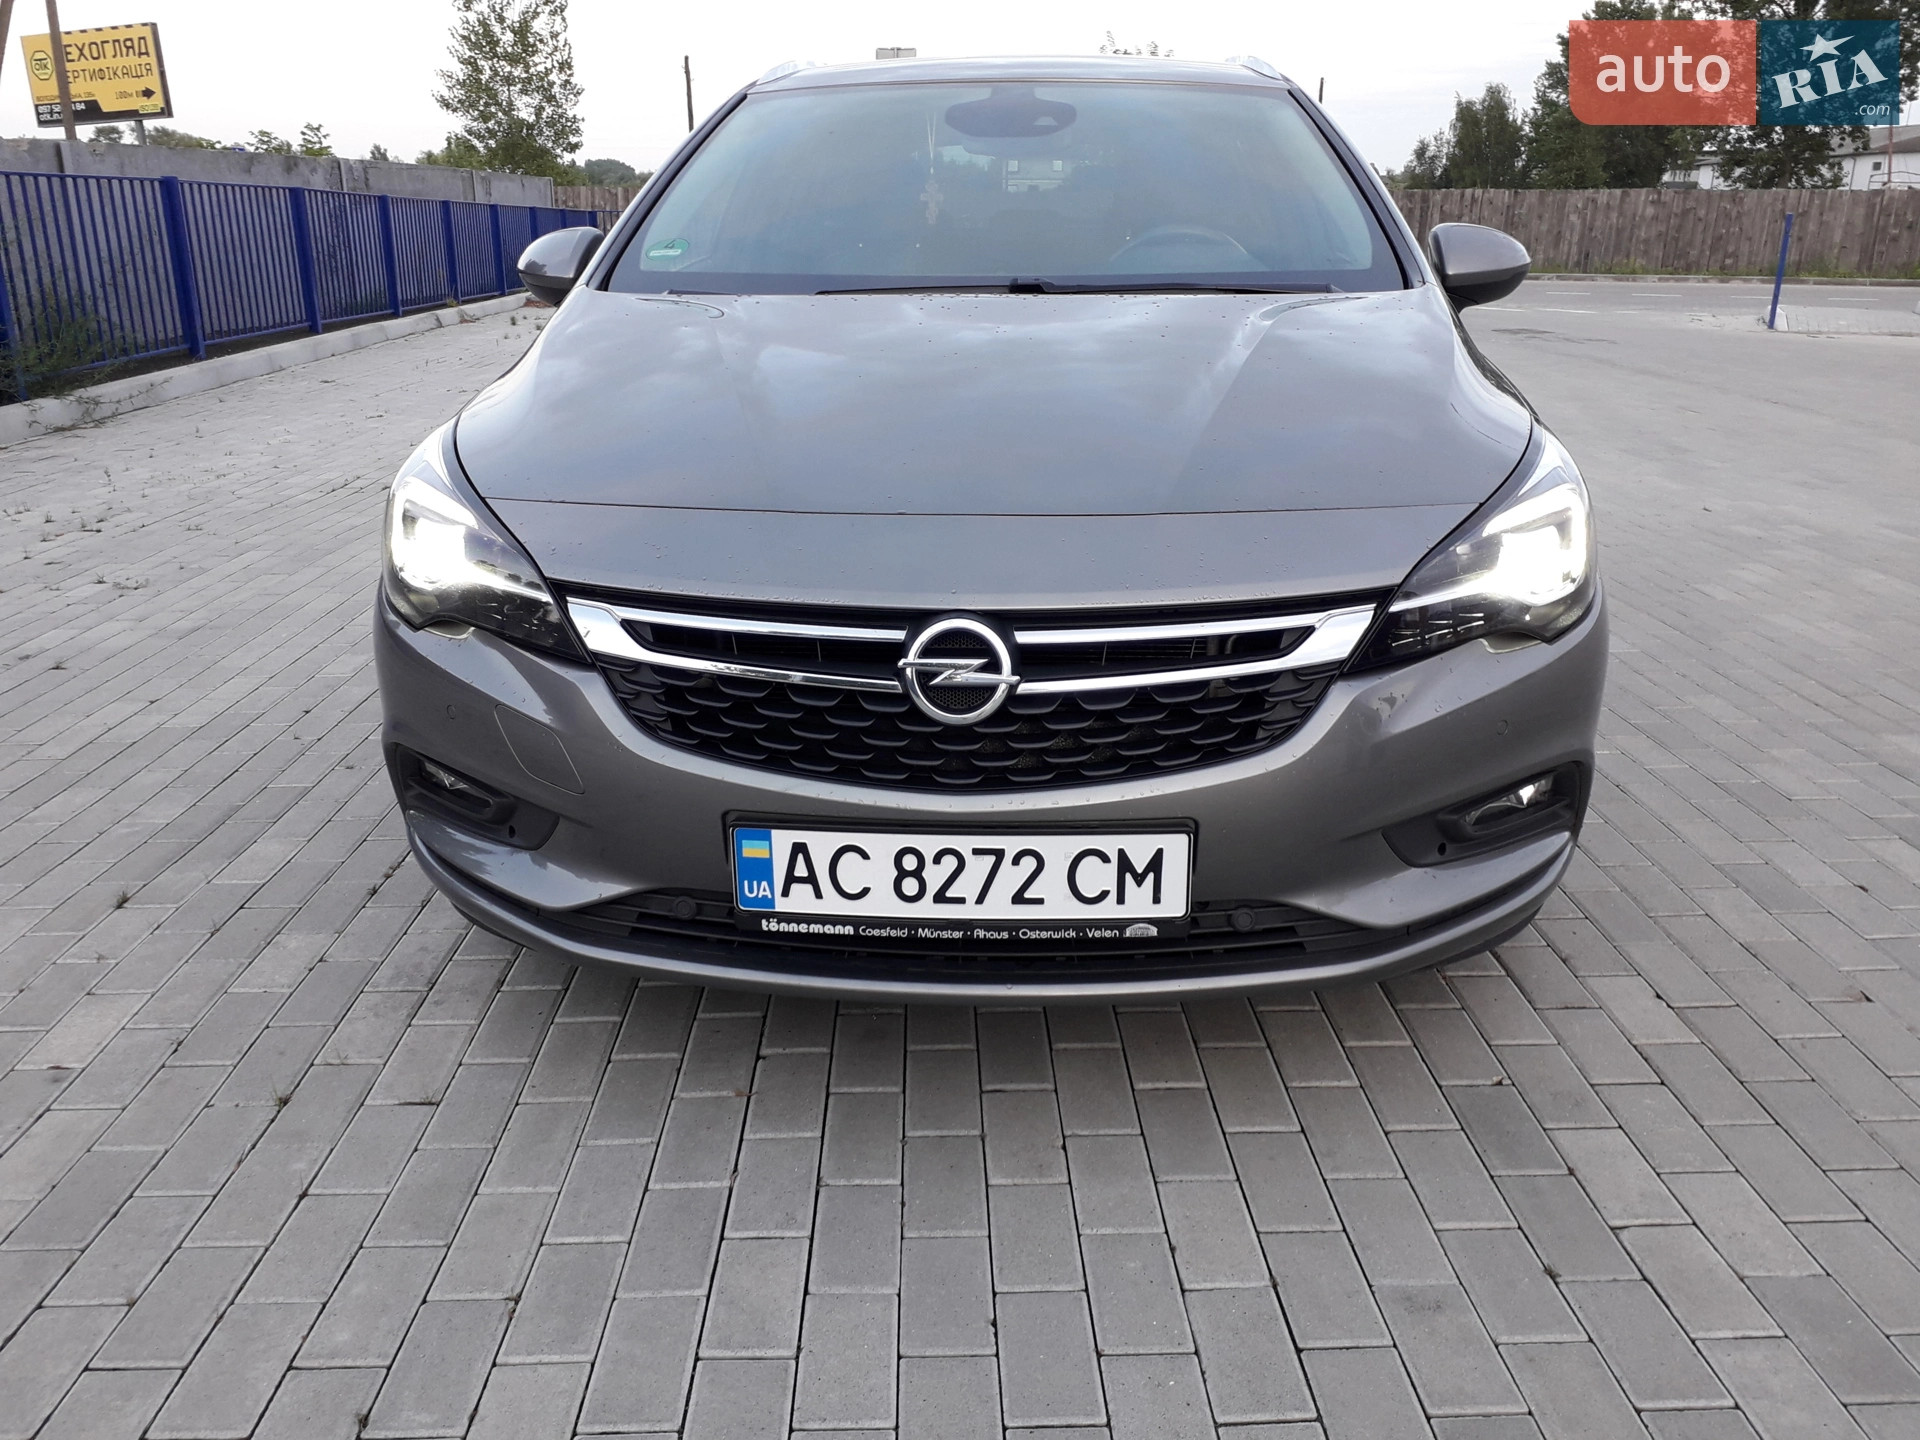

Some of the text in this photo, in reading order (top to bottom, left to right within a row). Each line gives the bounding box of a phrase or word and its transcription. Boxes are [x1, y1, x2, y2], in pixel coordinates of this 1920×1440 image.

[62, 36, 150, 63] ЕХОГЛЯД
[65, 62, 154, 84] ЕРТИФІКАЦІЯ
[780, 841, 1164, 906] AC 8272 CM
[744, 879, 772, 899] UA
[761, 918, 1120, 940] tönnemann Coesfeld Münster Ahaus Osterwick Velen
